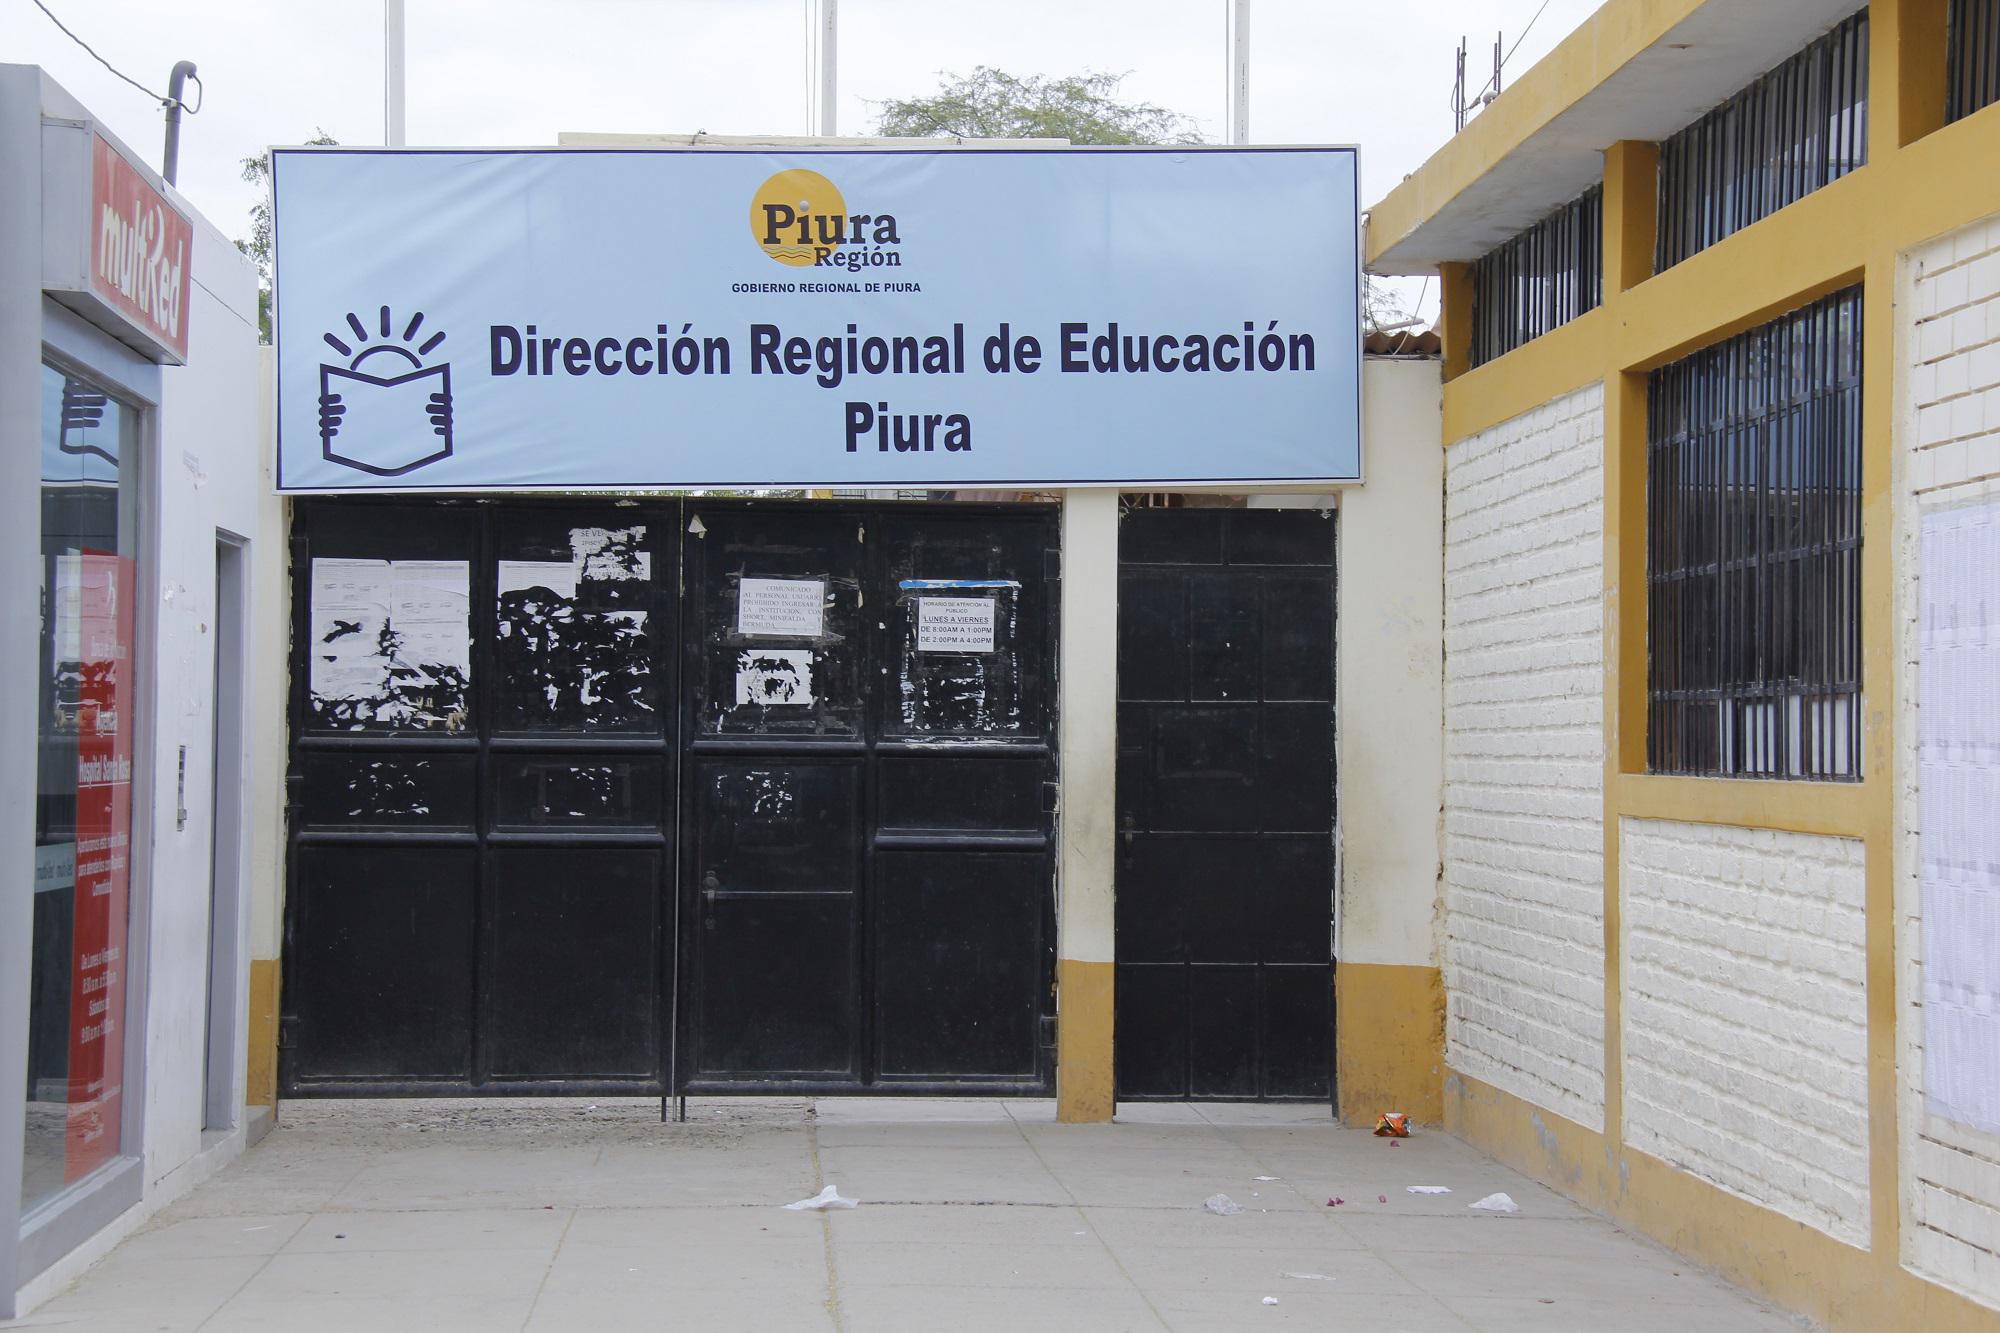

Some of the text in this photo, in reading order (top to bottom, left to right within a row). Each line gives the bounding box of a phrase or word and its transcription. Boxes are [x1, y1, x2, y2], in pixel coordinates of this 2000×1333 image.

[763, 200, 901, 245] Piura
[814, 246, 902, 273] Región
[732, 282, 921, 293] GOBIERNO REGIONAL DE PIURA
[490, 319, 1316, 389] Dirección Regional de Educación
[845, 401, 972, 453] Piura
[766, 585, 812, 593] COMUNICADO
[79, 754, 102, 787] Hospital
